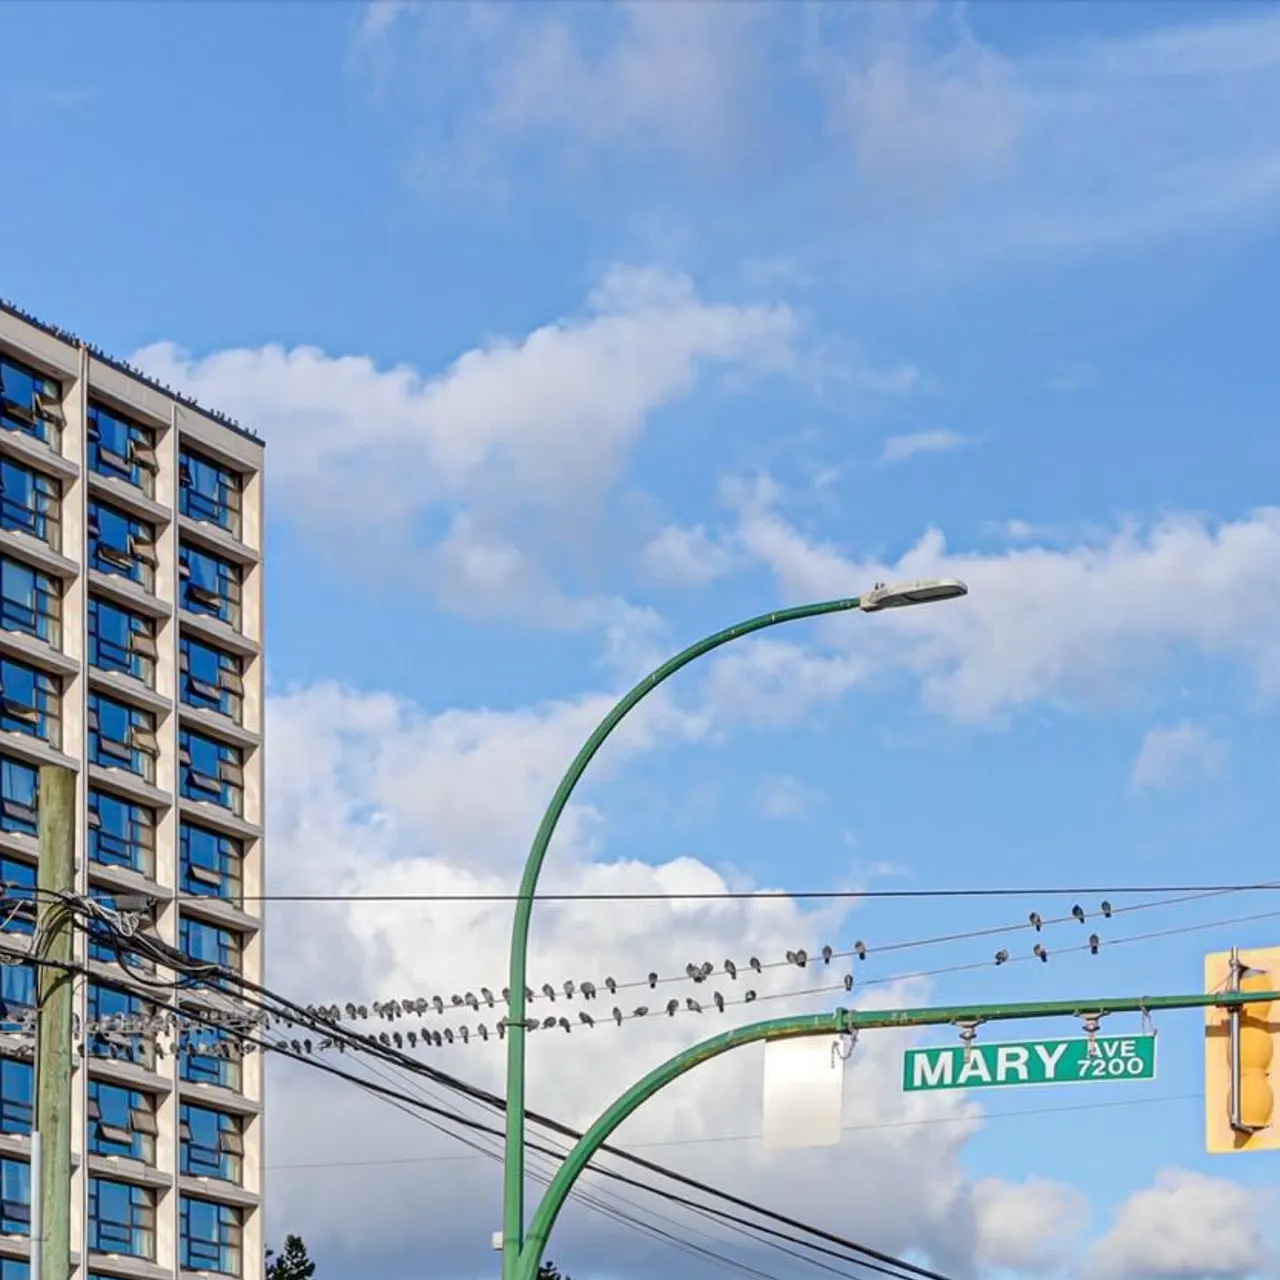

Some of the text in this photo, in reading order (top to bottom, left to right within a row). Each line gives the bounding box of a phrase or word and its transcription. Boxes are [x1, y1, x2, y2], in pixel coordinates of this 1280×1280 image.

[1086, 1039, 1137, 1059] AVE
[913, 1043, 1068, 1087] MARY
[1077, 1058, 1144, 1077] 7200
